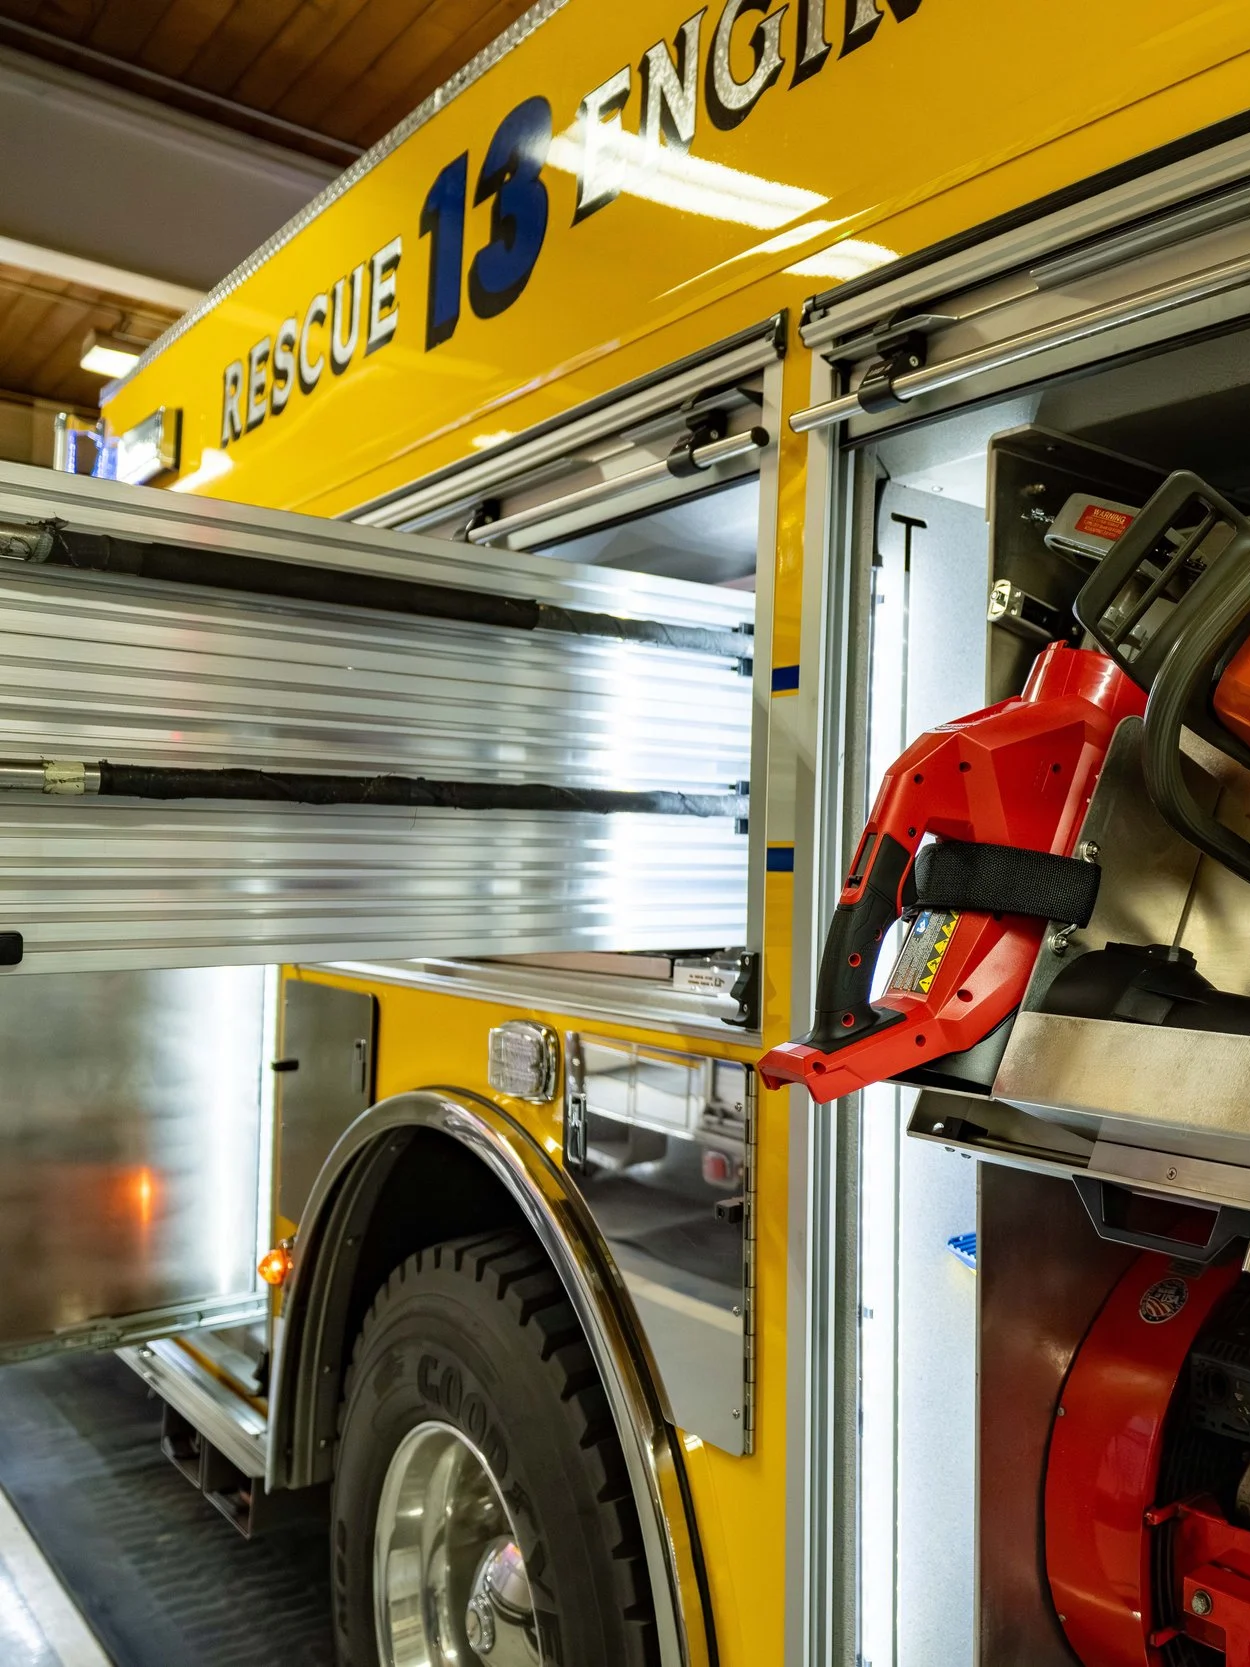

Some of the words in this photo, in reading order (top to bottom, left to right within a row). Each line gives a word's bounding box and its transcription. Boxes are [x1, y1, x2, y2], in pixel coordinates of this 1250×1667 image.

[221, 234, 403, 448] RESCUE
[418, 95, 554, 354] 13
[1093, 508, 1127, 523] WARNING
